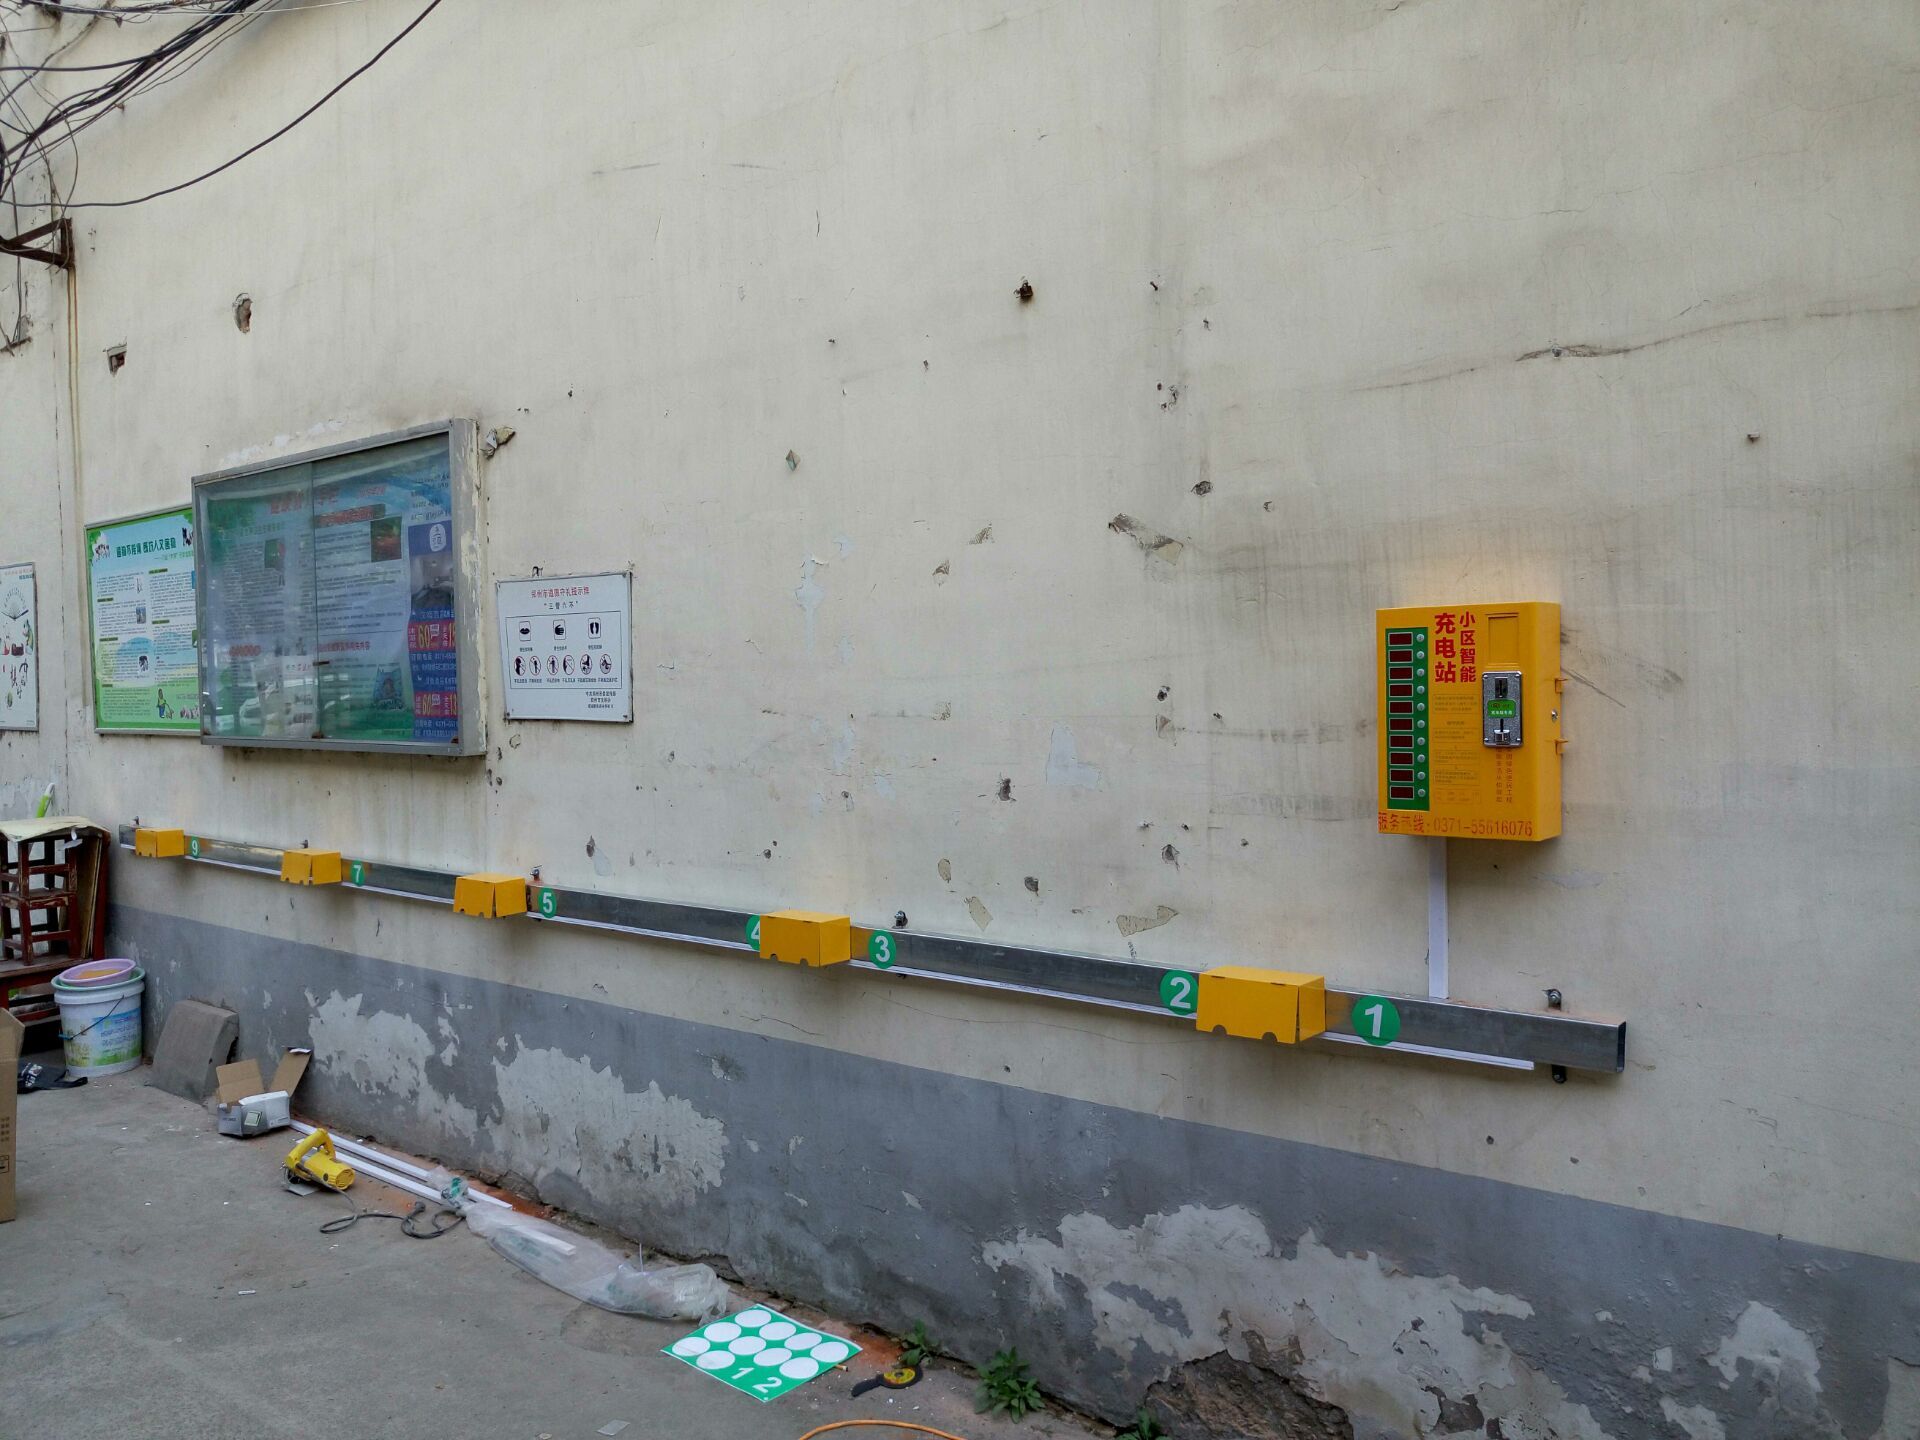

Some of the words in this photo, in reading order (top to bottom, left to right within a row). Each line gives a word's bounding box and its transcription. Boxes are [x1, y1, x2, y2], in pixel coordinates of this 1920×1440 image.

[1434, 612, 1456, 683] 充电站
[1460, 611, 1476, 683] 小区智能
[191, 839, 198, 856] 9
[353, 865, 362, 882] 7
[542, 892, 552, 913] 5
[874, 935, 891, 963] 3
[1169, 976, 1191, 1009] 2
[1364, 1003, 1383, 1038] 1
[752, 1376, 783, 1393] 2
